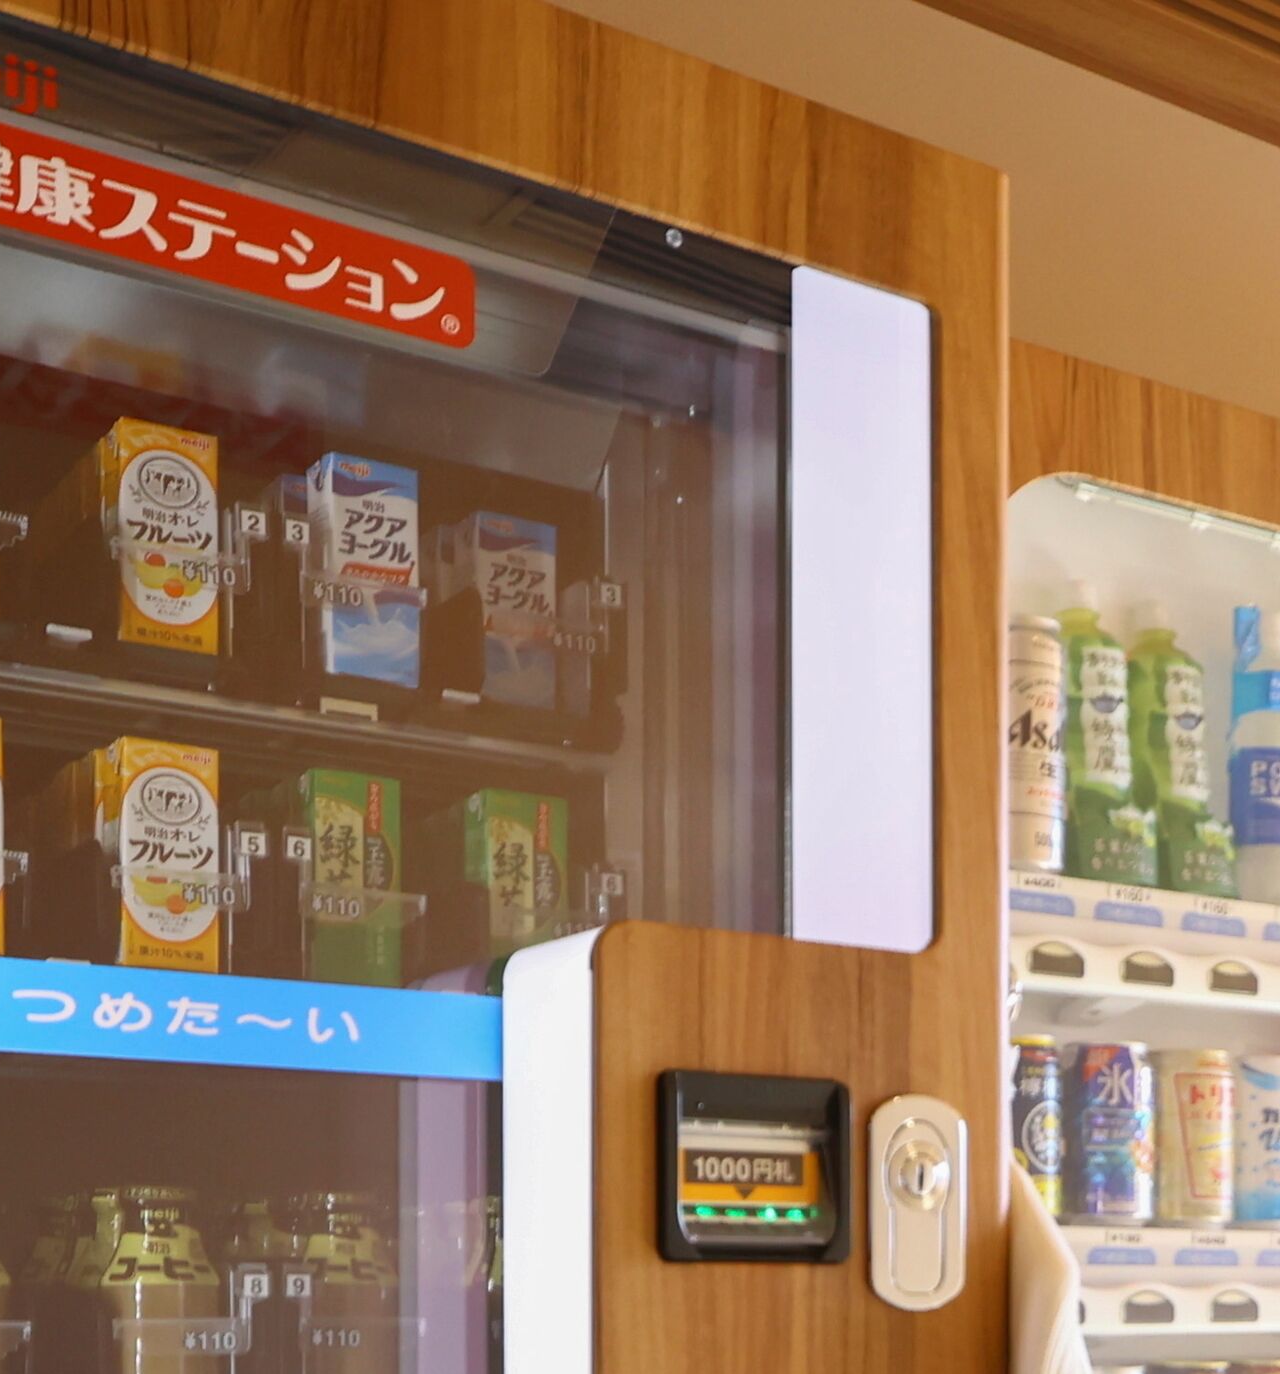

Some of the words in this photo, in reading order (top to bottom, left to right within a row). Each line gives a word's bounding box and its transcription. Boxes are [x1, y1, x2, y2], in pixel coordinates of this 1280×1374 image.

[180, 435, 211, 450] meiji
[247, 514, 260, 531] 2
[344, 508, 408, 538] アクア
[125, 518, 214, 551] フルーツ
[290, 524, 305, 542] 3
[182, 559, 237, 586] ¥110
[489, 562, 546, 589] アクア
[314, 582, 362, 606] ¥110
[605, 584, 616, 602] 3
[182, 752, 212, 765] meiji
[247, 836, 259, 853] 5
[293, 840, 305, 858] 6
[128, 838, 214, 871] フルーツ
[182, 883, 235, 906] ¥110
[312, 893, 361, 918] ¥110
[694, 1155, 794, 1182] 1000円札
[251, 1278, 261, 1294] 8
[293, 1279, 305, 1294] 9
[184, 1331, 237, 1351] ¥110
[313, 1329, 360, 1347] ¥110
